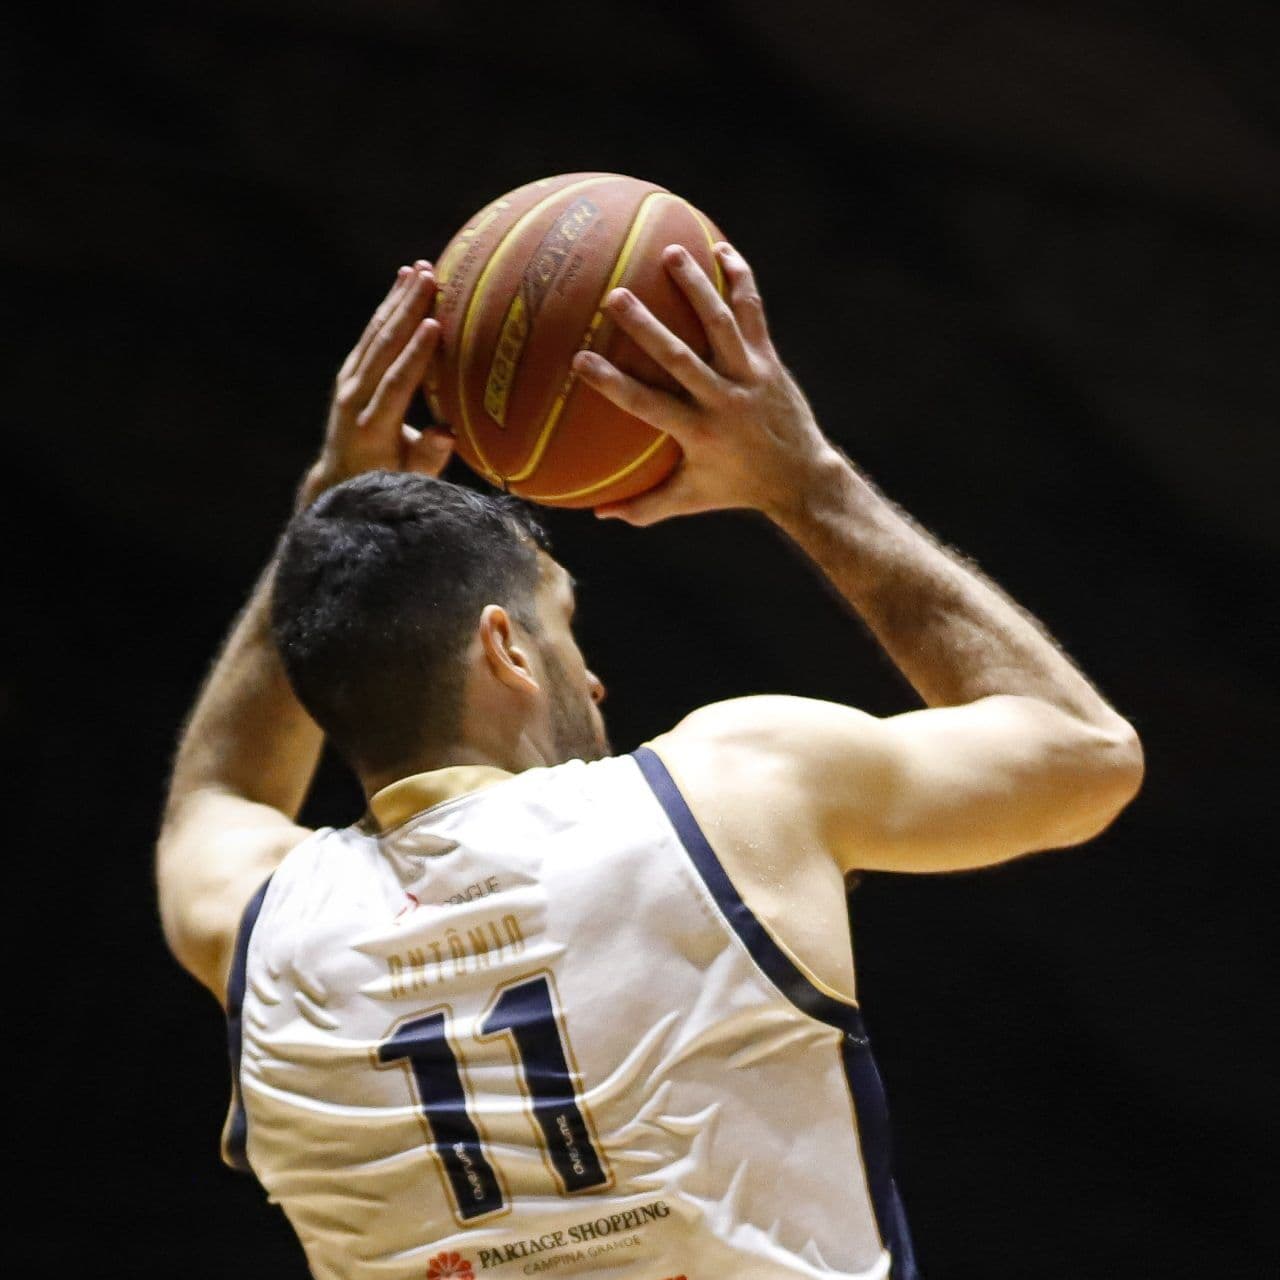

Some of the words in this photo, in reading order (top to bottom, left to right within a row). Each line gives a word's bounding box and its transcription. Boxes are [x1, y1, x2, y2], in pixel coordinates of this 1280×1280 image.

[386, 912, 526, 999] ANTÔNIO
[371, 969, 613, 1226] 11
[477, 1230, 569, 1269] PARTAGE
[568, 1200, 671, 1243] SHOPPING
[523, 1250, 585, 1276] CAMPINA
